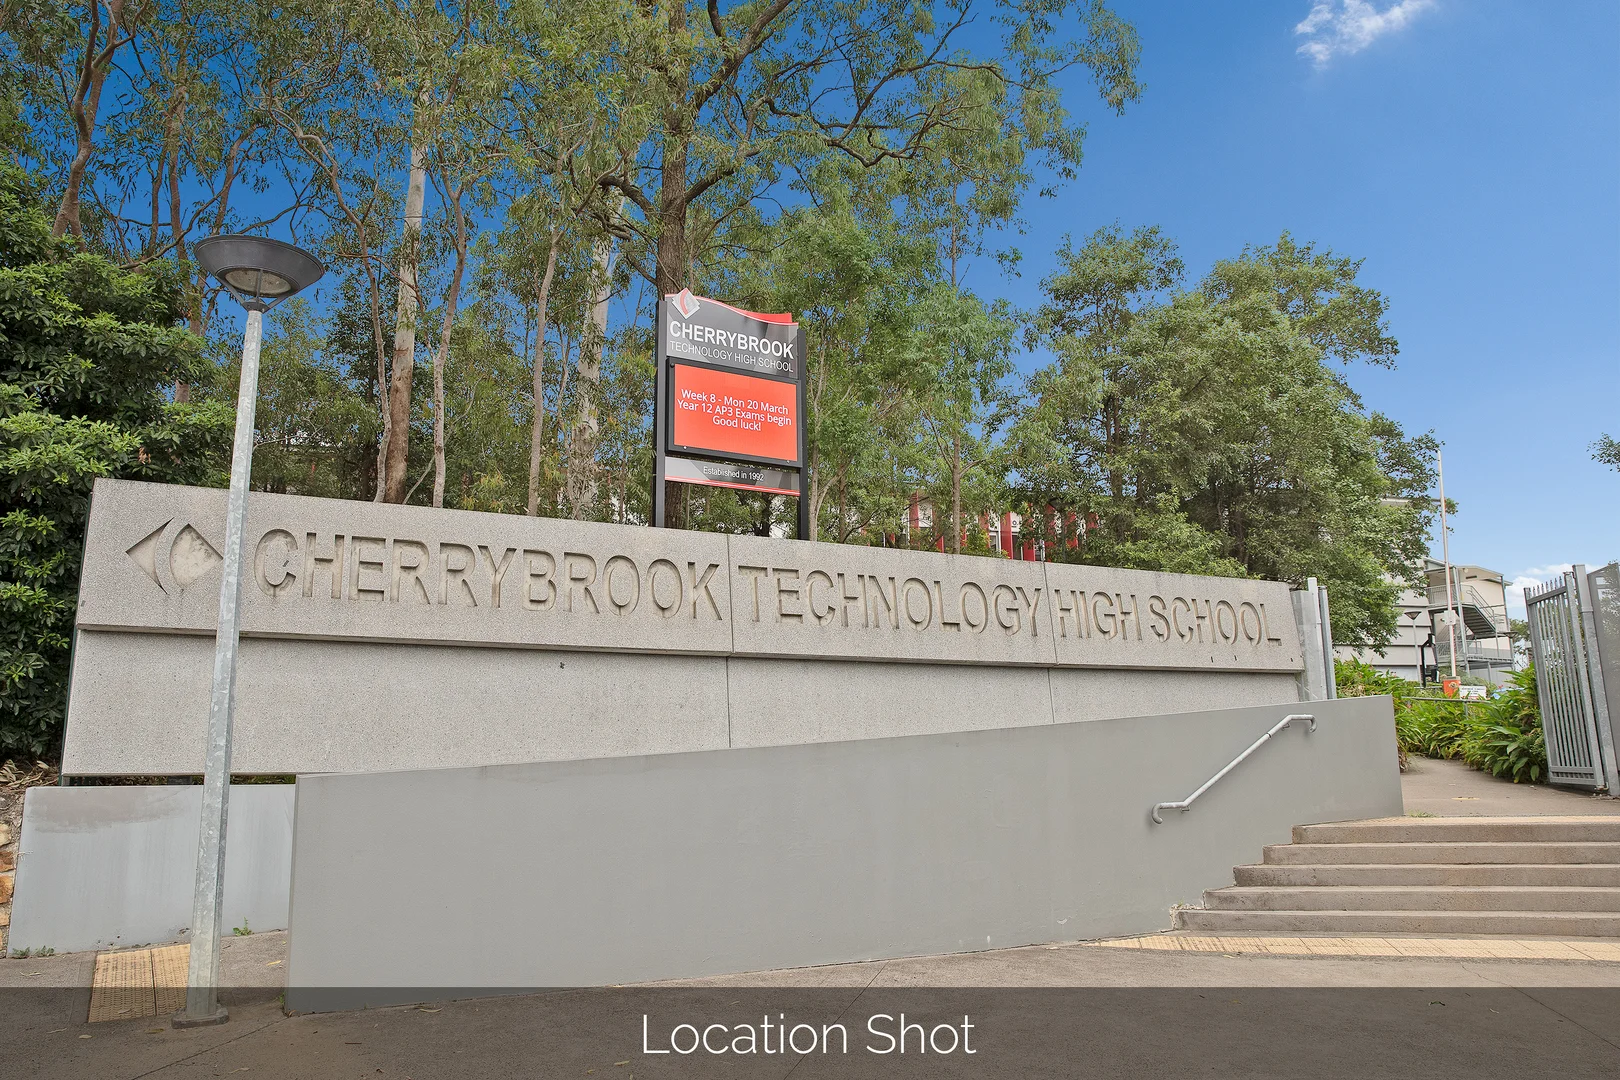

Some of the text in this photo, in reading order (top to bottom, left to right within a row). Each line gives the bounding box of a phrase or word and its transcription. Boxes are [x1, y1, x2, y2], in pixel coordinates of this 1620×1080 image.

[670, 321, 794, 359] CHERRYBROOK
[670, 340, 794, 373] TECHNOLOGY HIGH SCHOOL
[677, 399, 792, 426] Year 12 AP3 Exams begin
[681, 388, 707, 402] Week
[710, 394, 716, 403] 8
[724, 395, 744, 408] Mon
[747, 400, 758, 410] 20
[760, 402, 788, 415] March
[713, 416, 761, 431] Good luck!
[703, 466, 764, 481] Established in 1992
[255, 528, 1282, 647] CHERRYBROOK TECHNOLOGY HIGH SCHOOL
